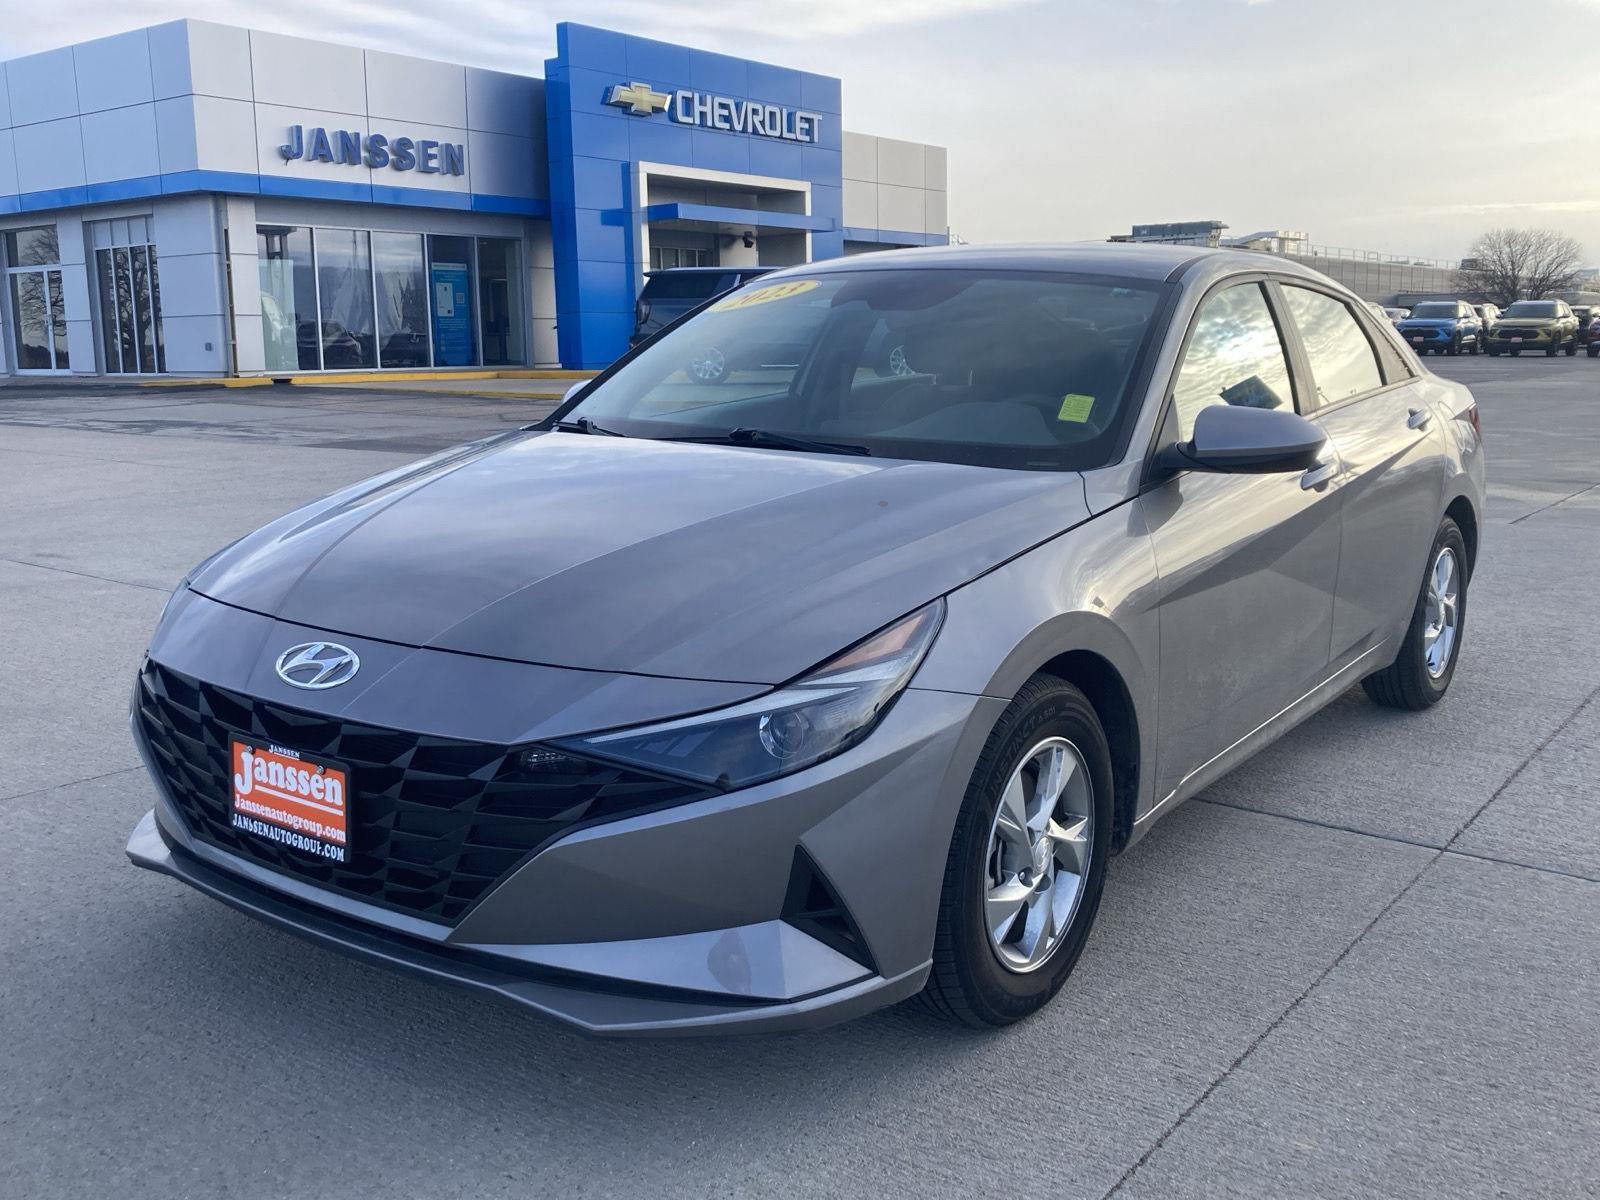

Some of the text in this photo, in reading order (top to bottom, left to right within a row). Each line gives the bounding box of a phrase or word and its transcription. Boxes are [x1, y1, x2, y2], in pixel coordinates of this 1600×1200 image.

[675, 89, 823, 143] CHEVROLET
[279, 124, 465, 176] JANSSEN
[268, 744, 300, 759] JANSSEN
[234, 751, 343, 806] Janssen
[235, 794, 346, 842] Janssenautogroup.com
